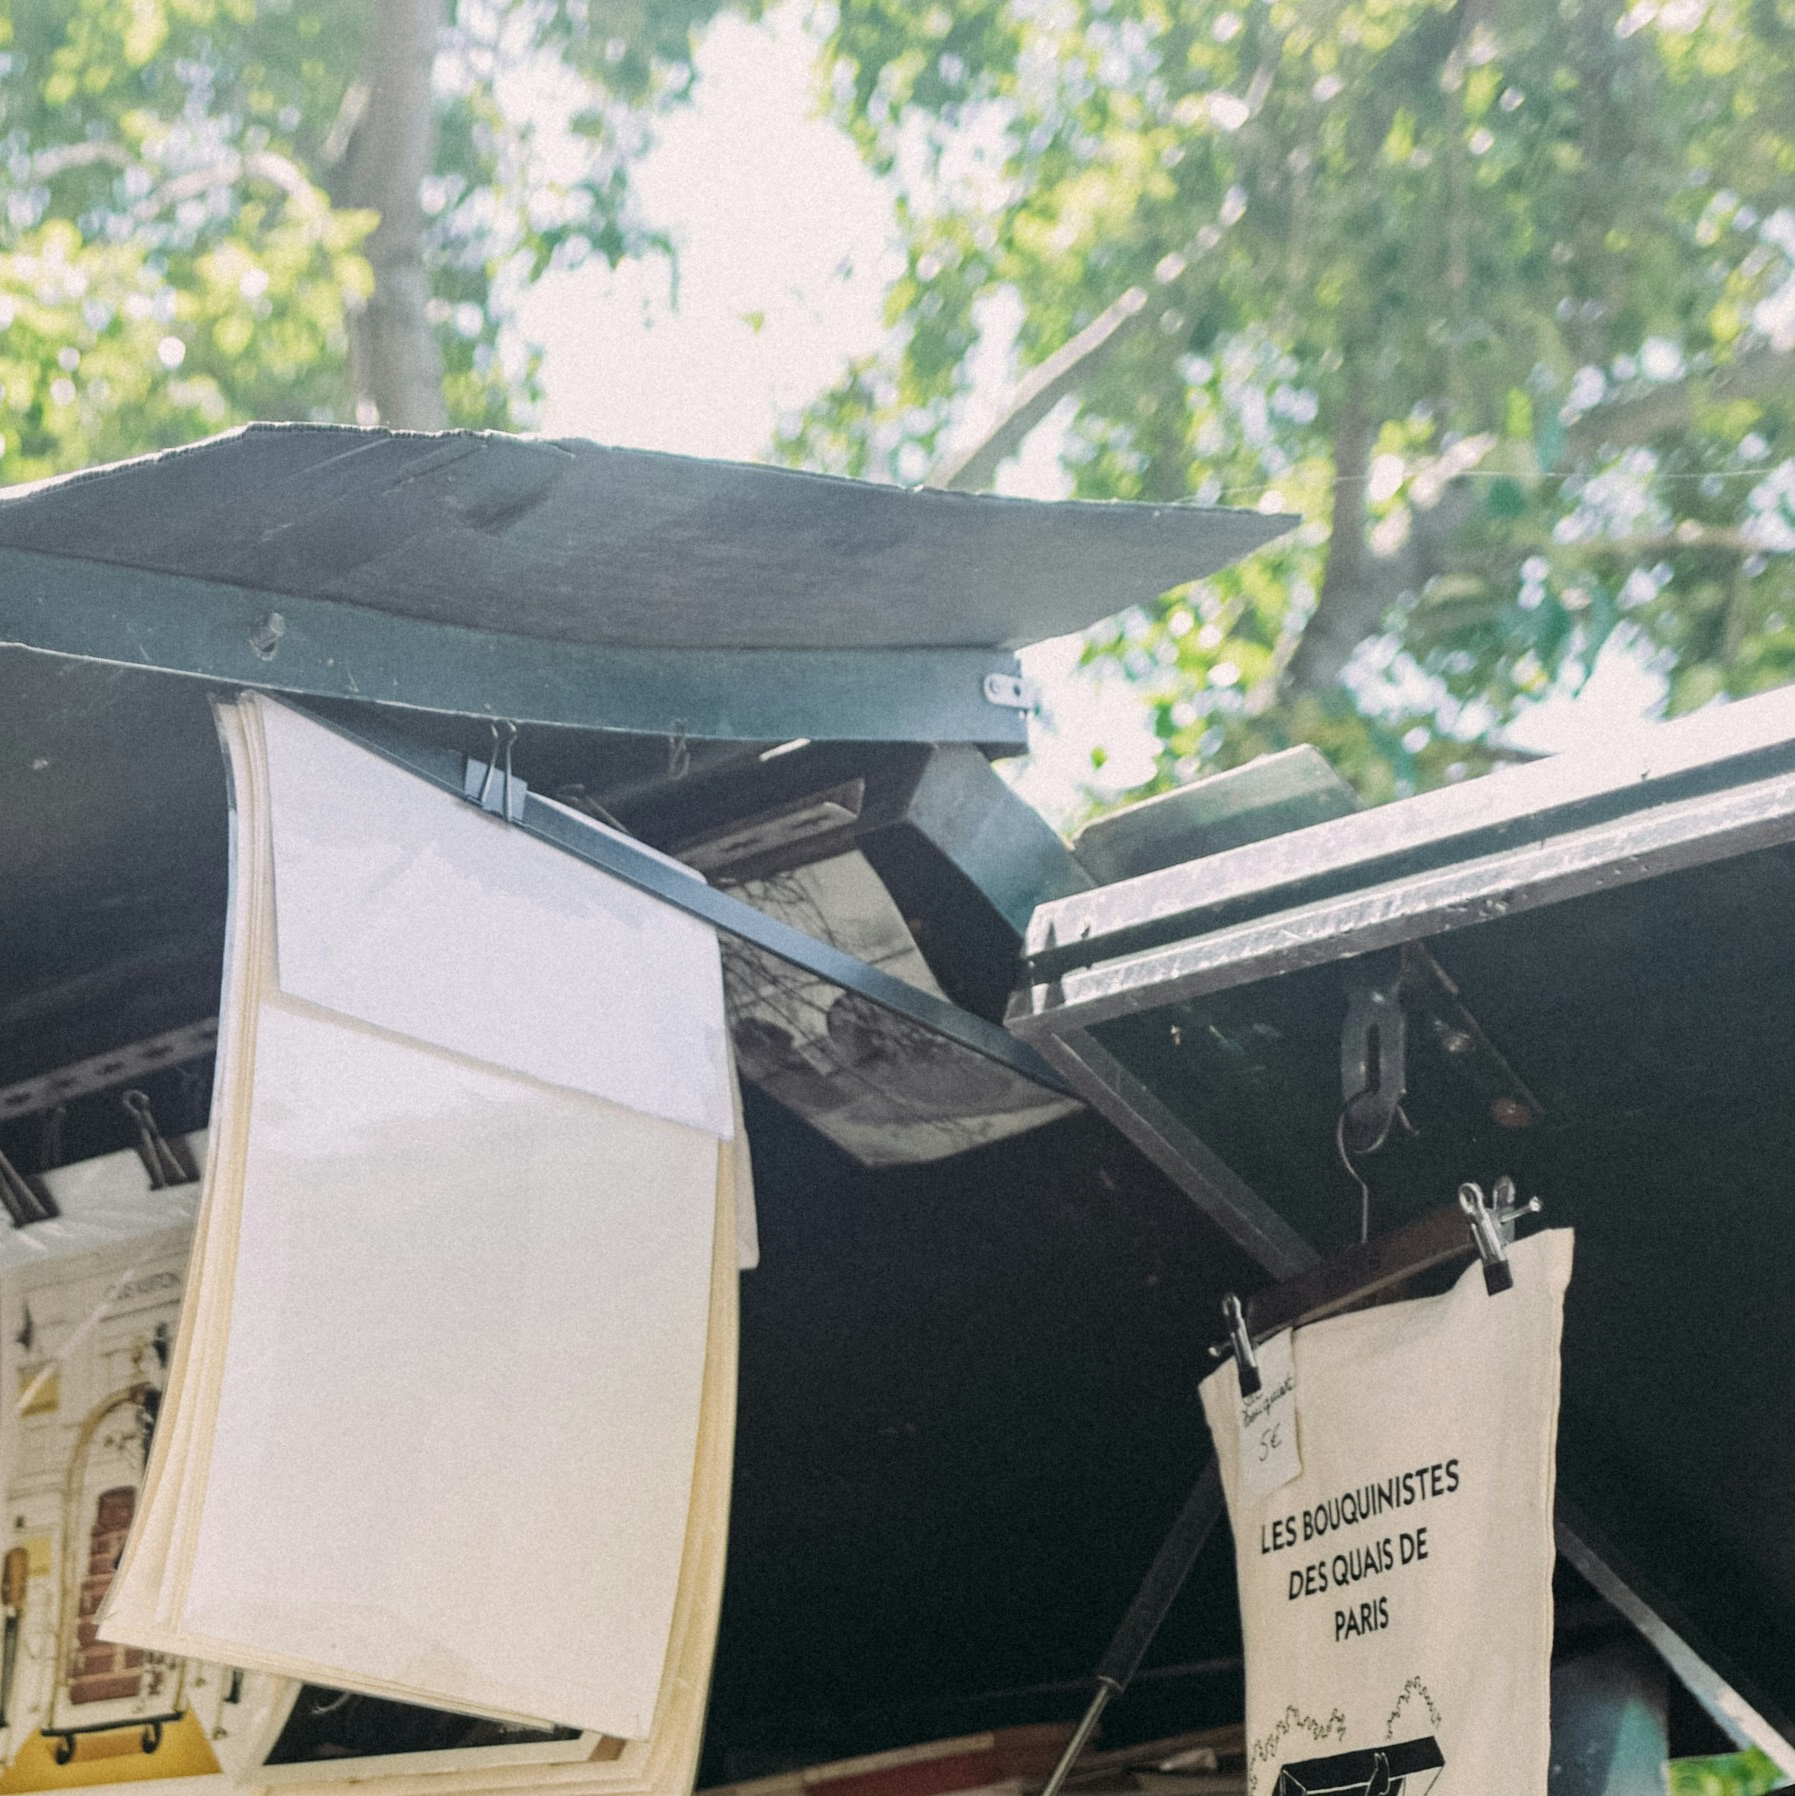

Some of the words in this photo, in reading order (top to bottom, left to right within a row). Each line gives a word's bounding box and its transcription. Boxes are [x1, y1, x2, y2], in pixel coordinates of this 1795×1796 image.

[1261, 1515, 1297, 1555] LES
[1302, 1458, 1460, 1542] BOUQUINISTES
[1288, 1561, 1329, 1601] DES
[1332, 1538, 1394, 1587] QUAIS
[1399, 1527, 1429, 1565] DE
[1334, 1596, 1389, 1642] PARIS
